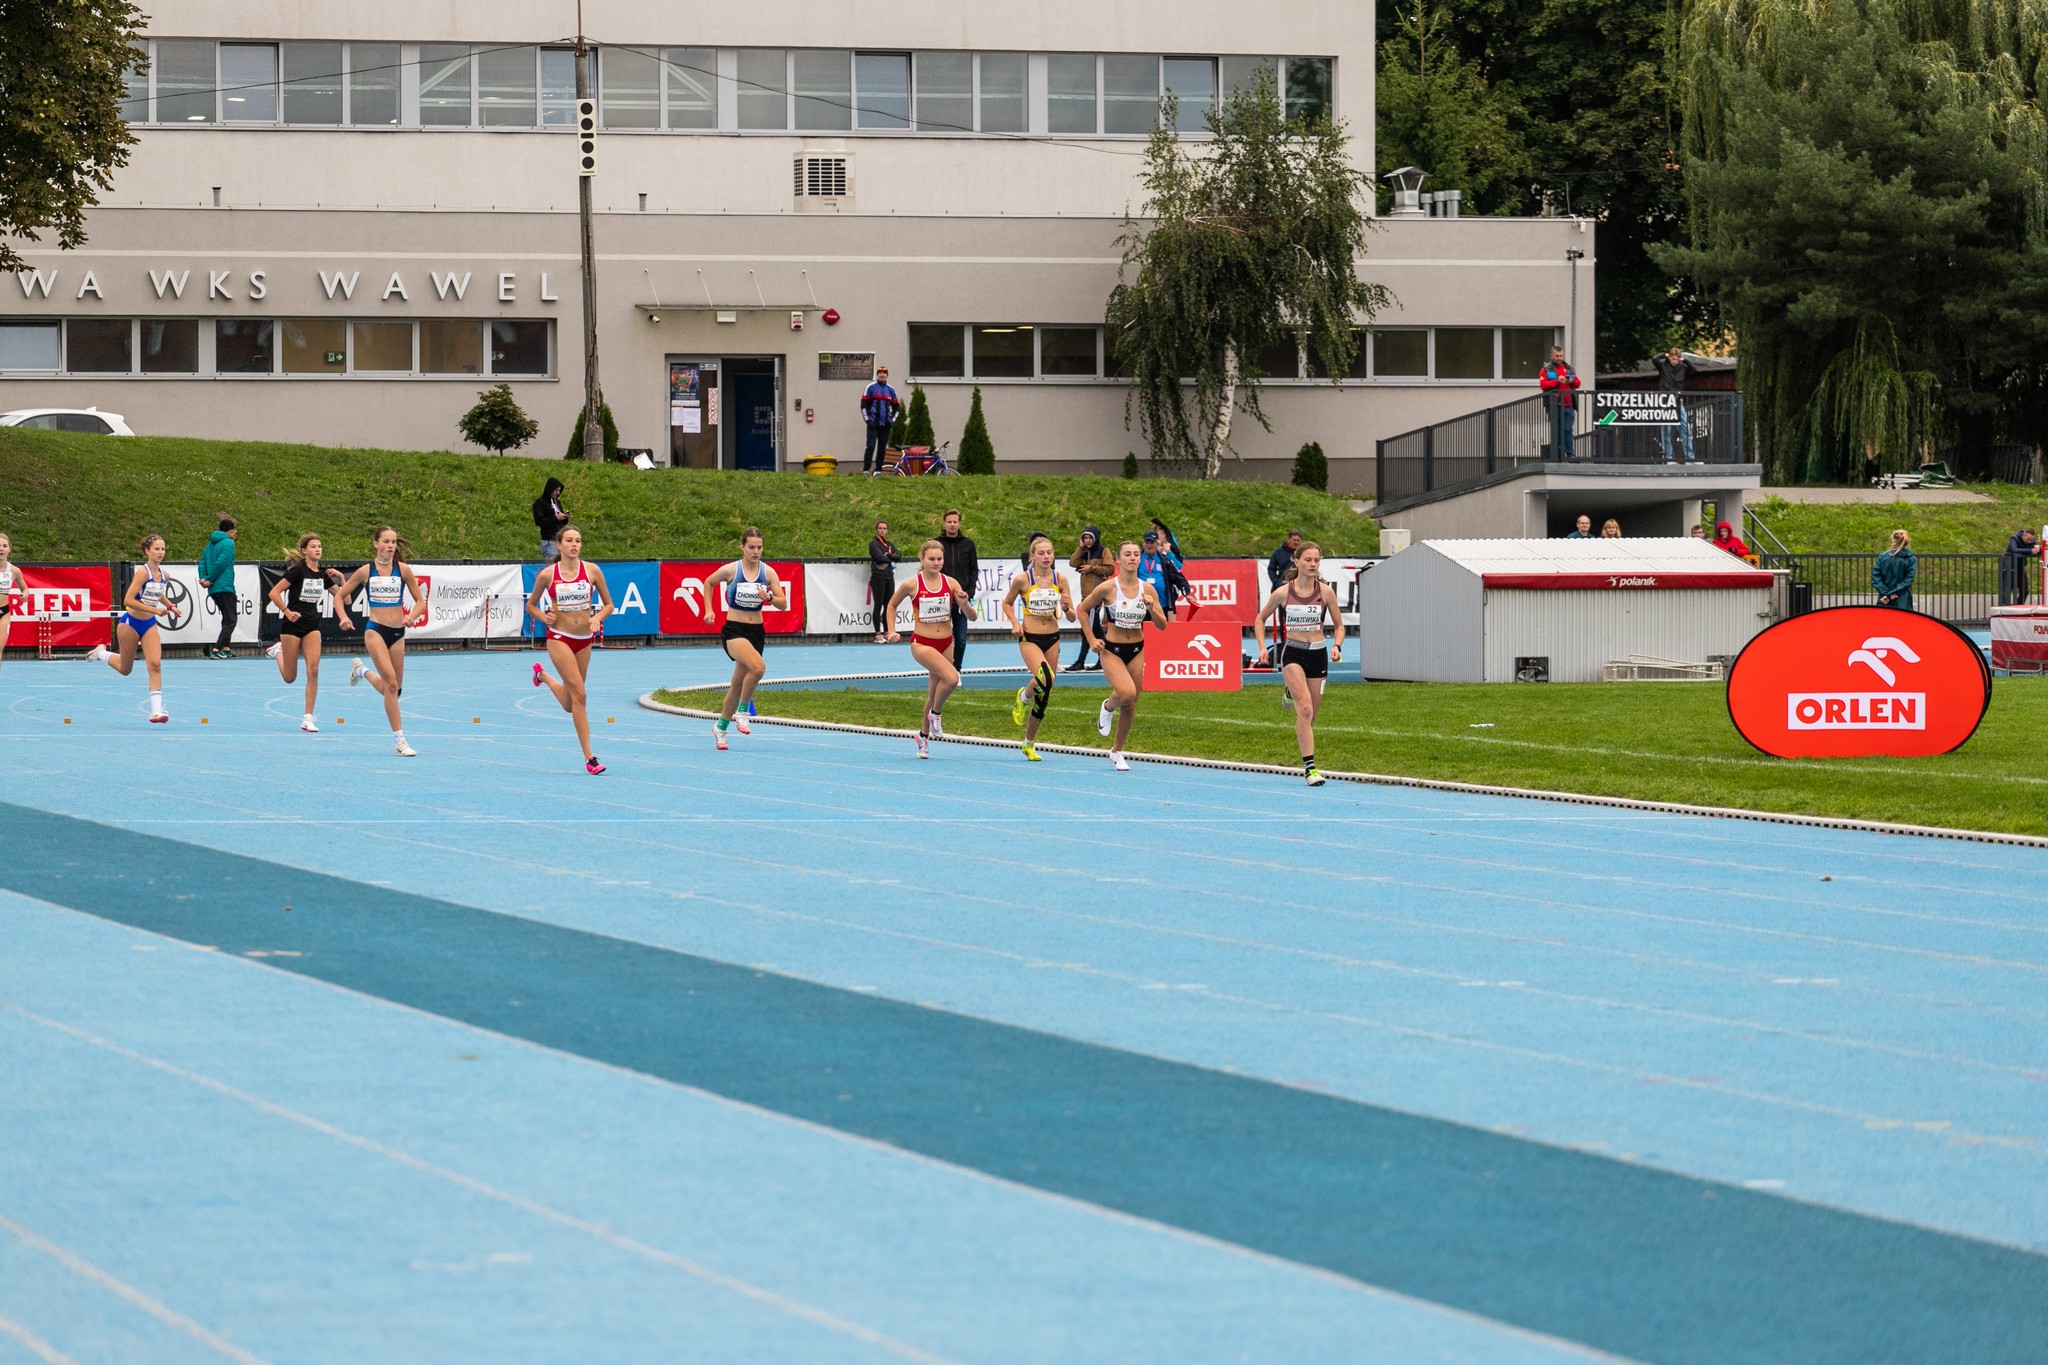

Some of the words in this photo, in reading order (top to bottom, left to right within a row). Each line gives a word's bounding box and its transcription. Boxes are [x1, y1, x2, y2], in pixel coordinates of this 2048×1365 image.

[149, 270, 266, 300] WKS
[318, 271, 559, 301] WAWEL
[1596, 393, 1677, 407] STRZELNICA
[1621, 409, 1678, 420] SPORTOWA
[1618, 576, 1656, 588] polanik
[371, 586, 399, 594] SIKORSKA
[1177, 584, 1231, 602] RLEN
[8, 594, 82, 615] RLEN
[558, 594, 589, 602] JAWORSKA
[473, 604, 513, 623] Turstyki
[1164, 663, 1218, 676] ORLEN
[1796, 698, 1916, 724] ORLEN
